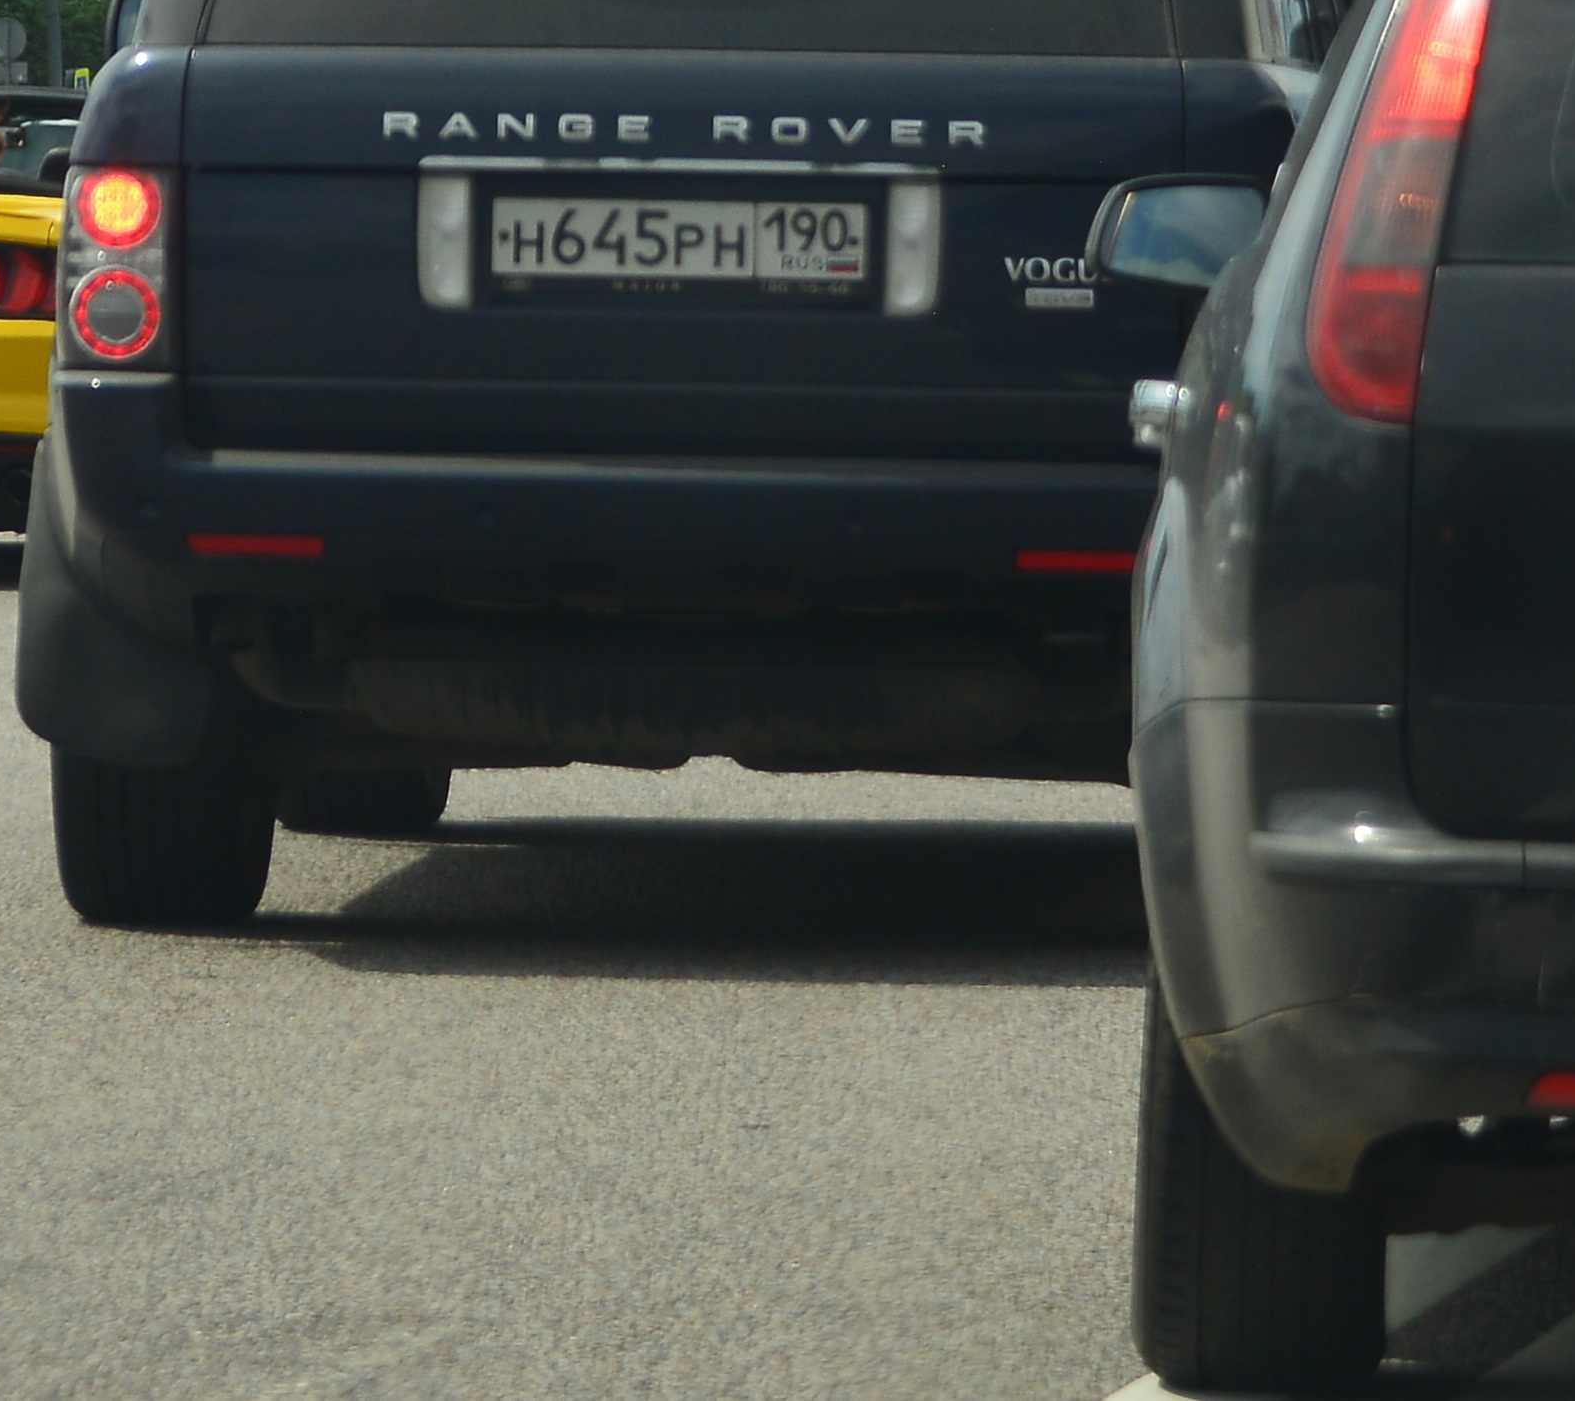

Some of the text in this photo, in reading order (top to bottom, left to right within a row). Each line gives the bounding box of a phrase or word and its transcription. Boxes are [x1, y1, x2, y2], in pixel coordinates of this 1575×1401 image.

[382, 111, 985, 144] RANGE ROVER
[762, 207, 849, 253] 190
[781, 254, 826, 272] RUS
[1003, 256, 1100, 282] VOGU
